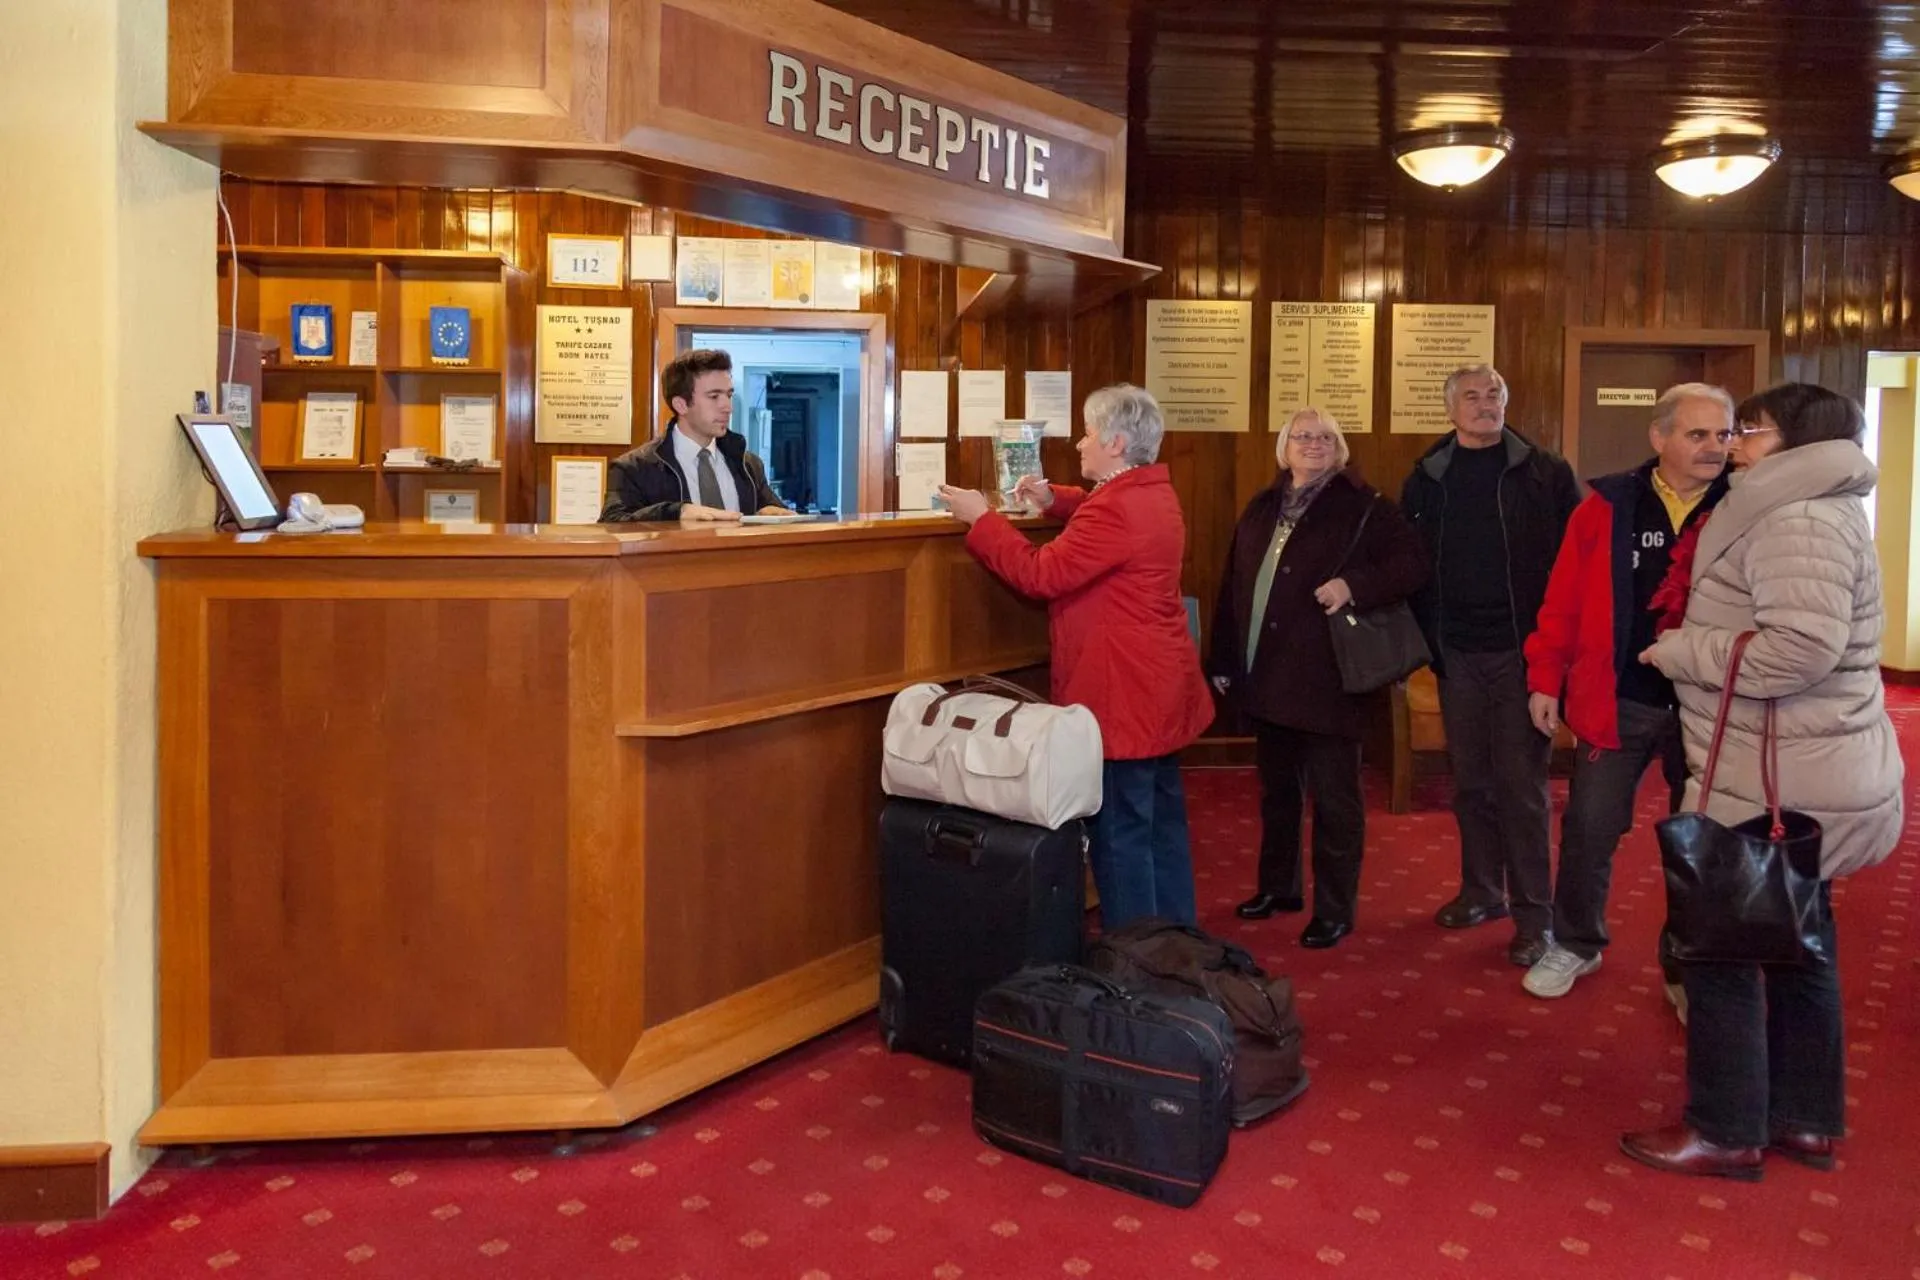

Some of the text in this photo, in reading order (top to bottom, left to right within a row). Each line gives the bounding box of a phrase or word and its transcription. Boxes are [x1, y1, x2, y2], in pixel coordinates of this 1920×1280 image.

[767, 50, 1051, 200] RECEPTIE
[572, 257, 599, 273] 112
[1313, 304, 1365, 315] SUPLIMENTARE
[548, 315, 579, 324] HOTEL
[584, 352, 609, 360] RATES
